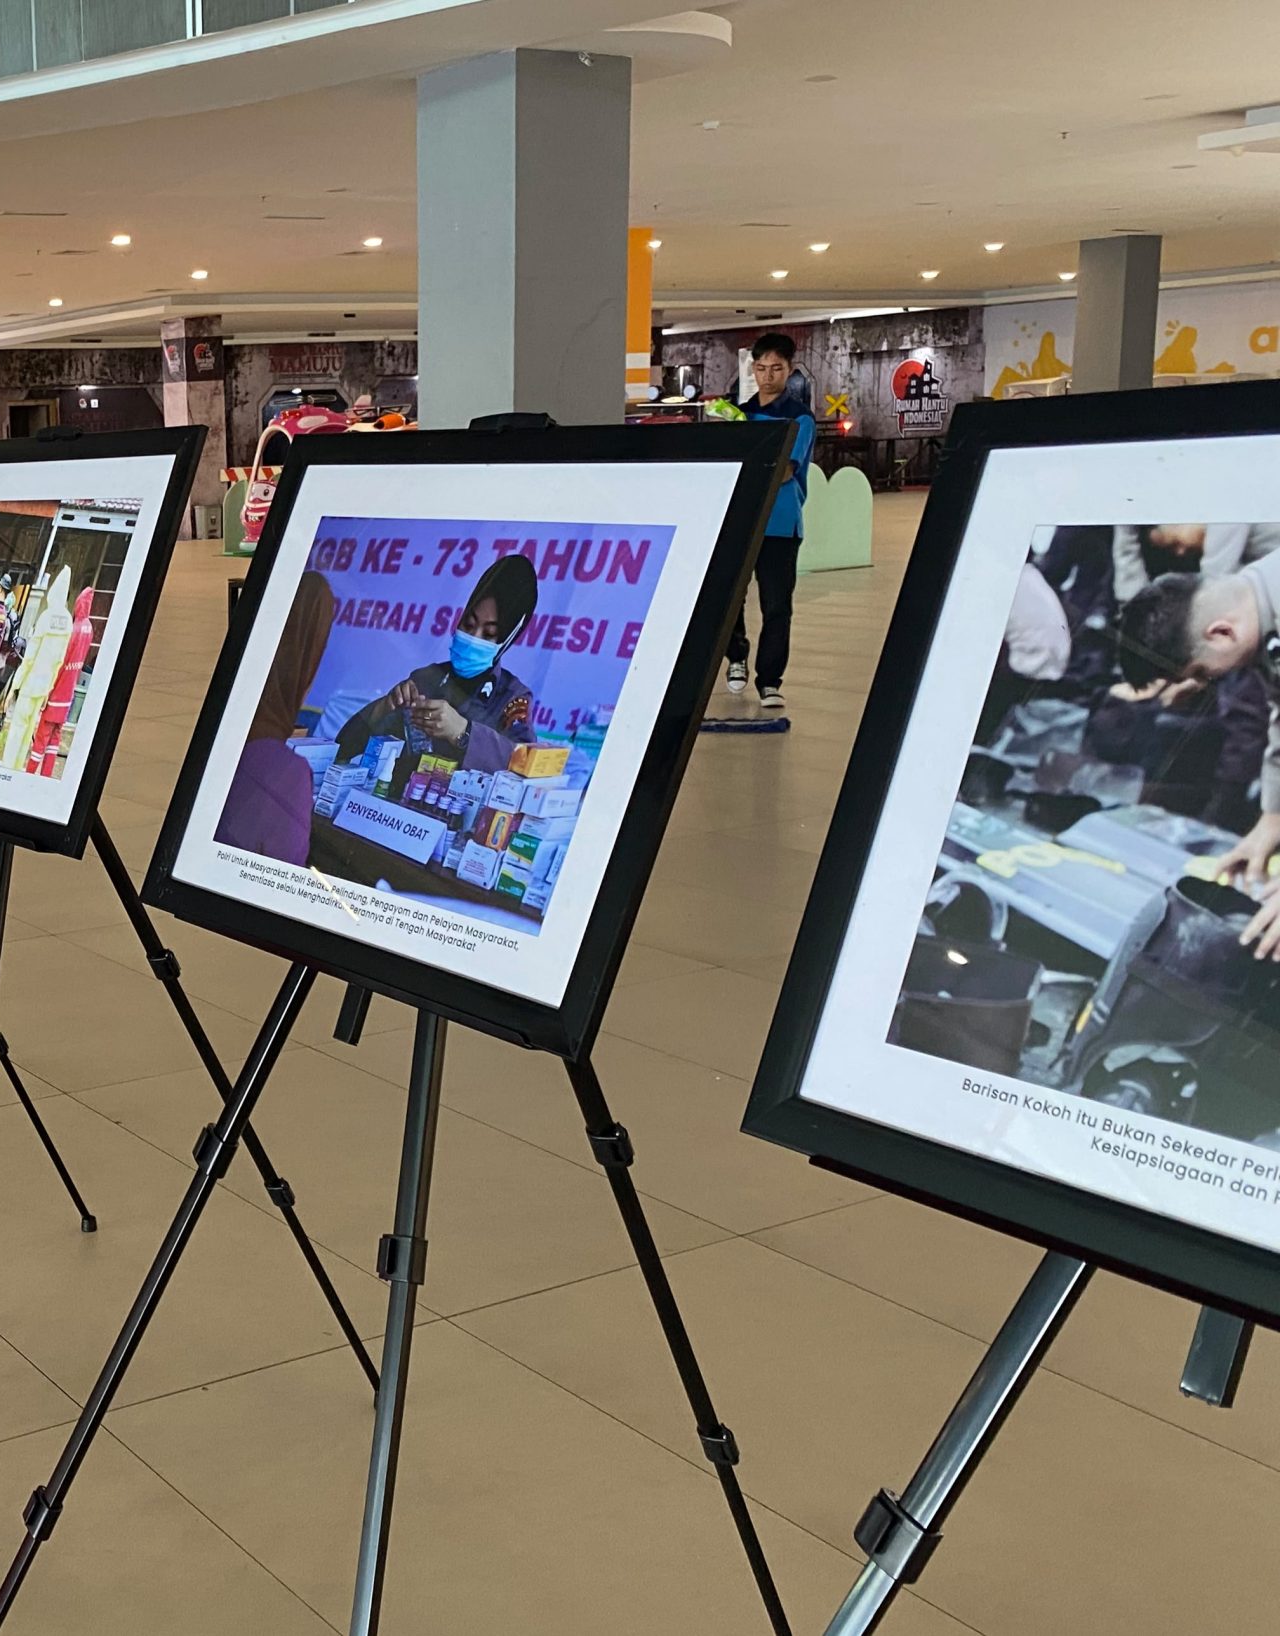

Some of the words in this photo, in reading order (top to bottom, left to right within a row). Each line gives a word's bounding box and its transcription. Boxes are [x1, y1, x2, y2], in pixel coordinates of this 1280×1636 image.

[896, 399, 920, 411] RUMAH
[359, 537, 409, 574] KE
[433, 538, 479, 577] 73
[345, 800, 404, 831] PENYERAHAN
[403, 823, 430, 841] OBAT
[217, 850, 231, 863] Polri
[231, 852, 249, 867] Untuk
[291, 872, 307, 885] Polri
[371, 897, 411, 918] Pengayom
[412, 910, 428, 922] dan
[430, 915, 463, 933] Pelayan
[465, 925, 519, 951] Masyarakat,
[239, 870, 275, 889] Senantiasa
[276, 881, 297, 895] selalu
[297, 888, 348, 911] Menghadirka
[386, 914, 394, 925] di
[395, 918, 425, 935] Tengah
[426, 928, 476, 952] Masyarakat
[962, 1078, 1018, 1105] Barisan
[1022, 1095, 1072, 1120] Kokoh
[1102, 1118, 1156, 1146] Bukan
[1161, 1136, 1238, 1168] Sekedar
[1241, 1158, 1280, 1182] Perl
[1090, 1136, 1224, 1188] Kesiapsiagaan
[1230, 1179, 1268, 1201] dan
